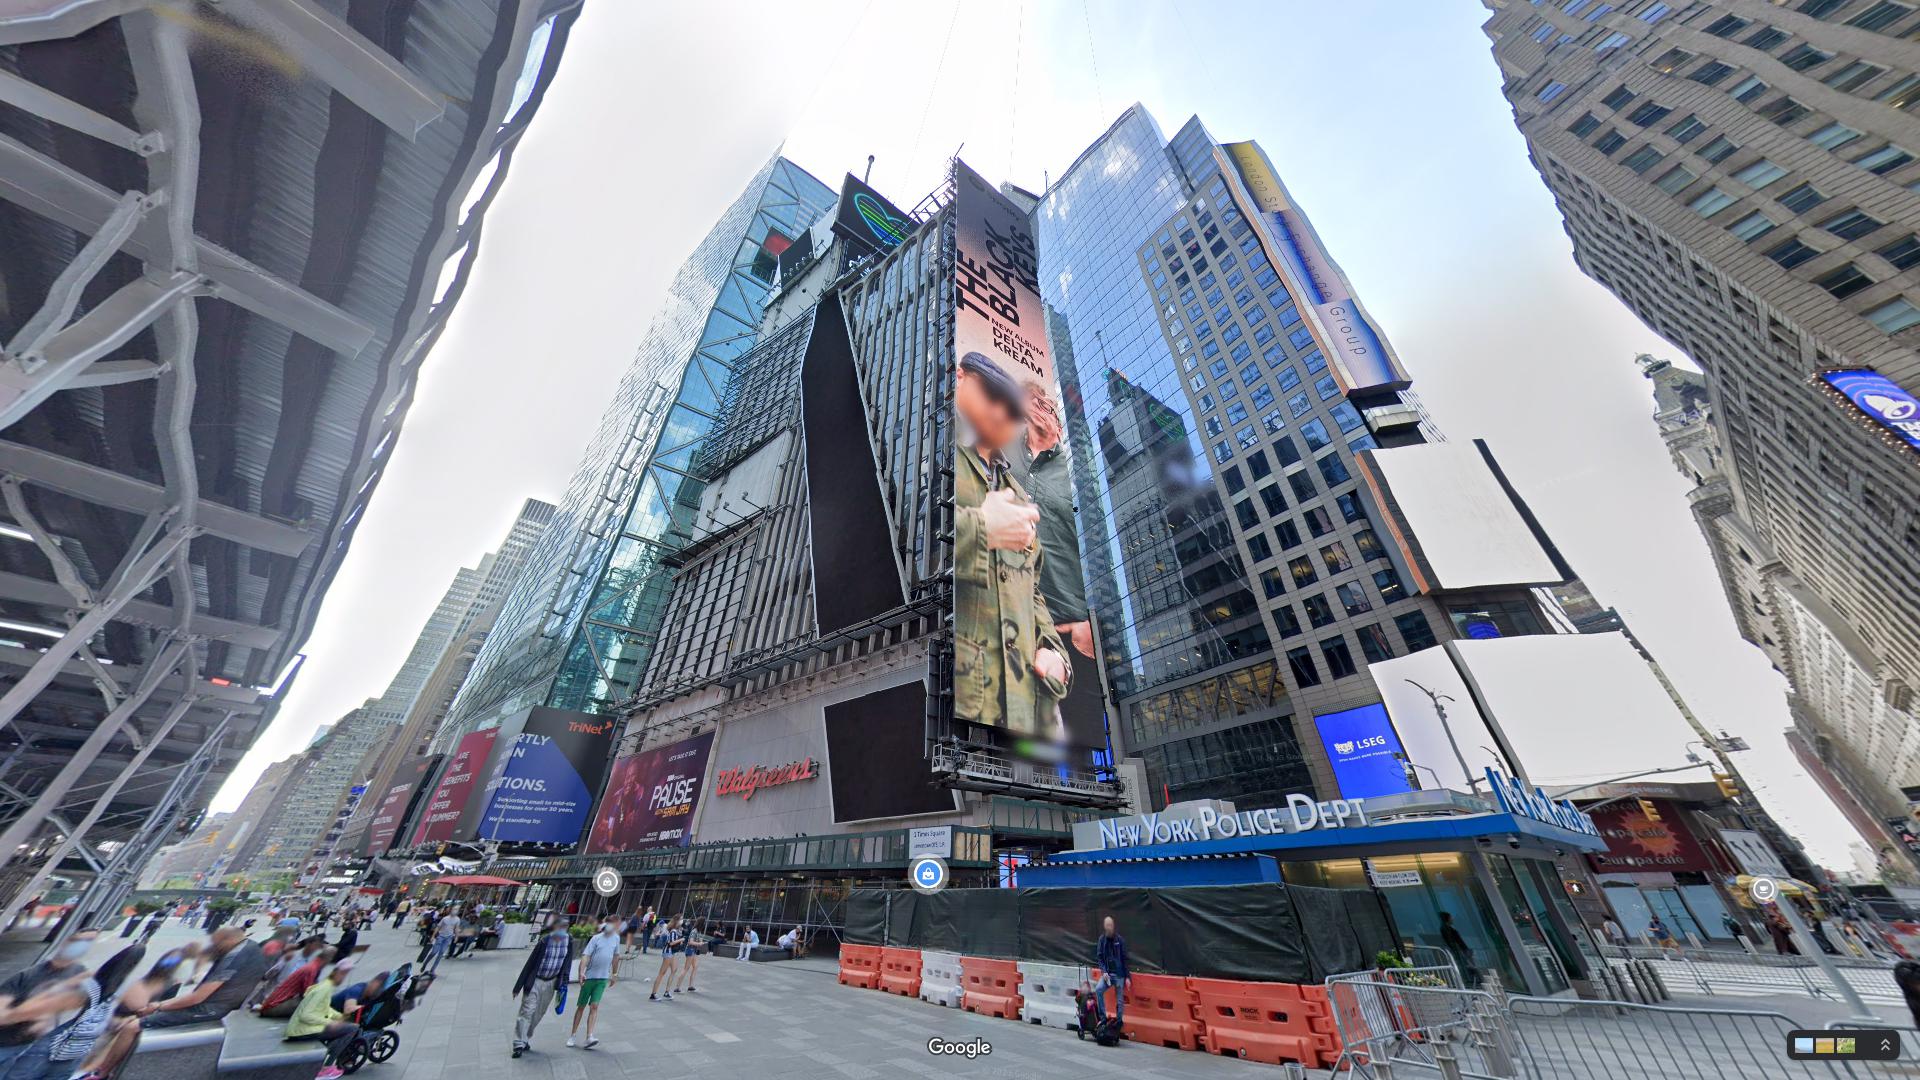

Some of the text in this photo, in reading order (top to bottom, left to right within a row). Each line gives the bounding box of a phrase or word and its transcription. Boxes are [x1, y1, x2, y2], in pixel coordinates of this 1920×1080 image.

[984, 217, 1020, 327] BLACK
[1009, 224, 1041, 299] KEYS
[1239, 154, 1268, 193] London
[1330, 306, 1367, 356] Group
[956, 248, 990, 321] THE
[992, 317, 1045, 358] NEW ALBUM
[992, 326, 1035, 361] DELTA
[993, 338, 1044, 378] KREAM
[568, 721, 603, 735] TriNet
[1356, 735, 1386, 750] LSEG
[485, 776, 546, 792] TIONS.
[649, 777, 696, 811] PAUSE
[716, 757, 815, 801] Walgreens
